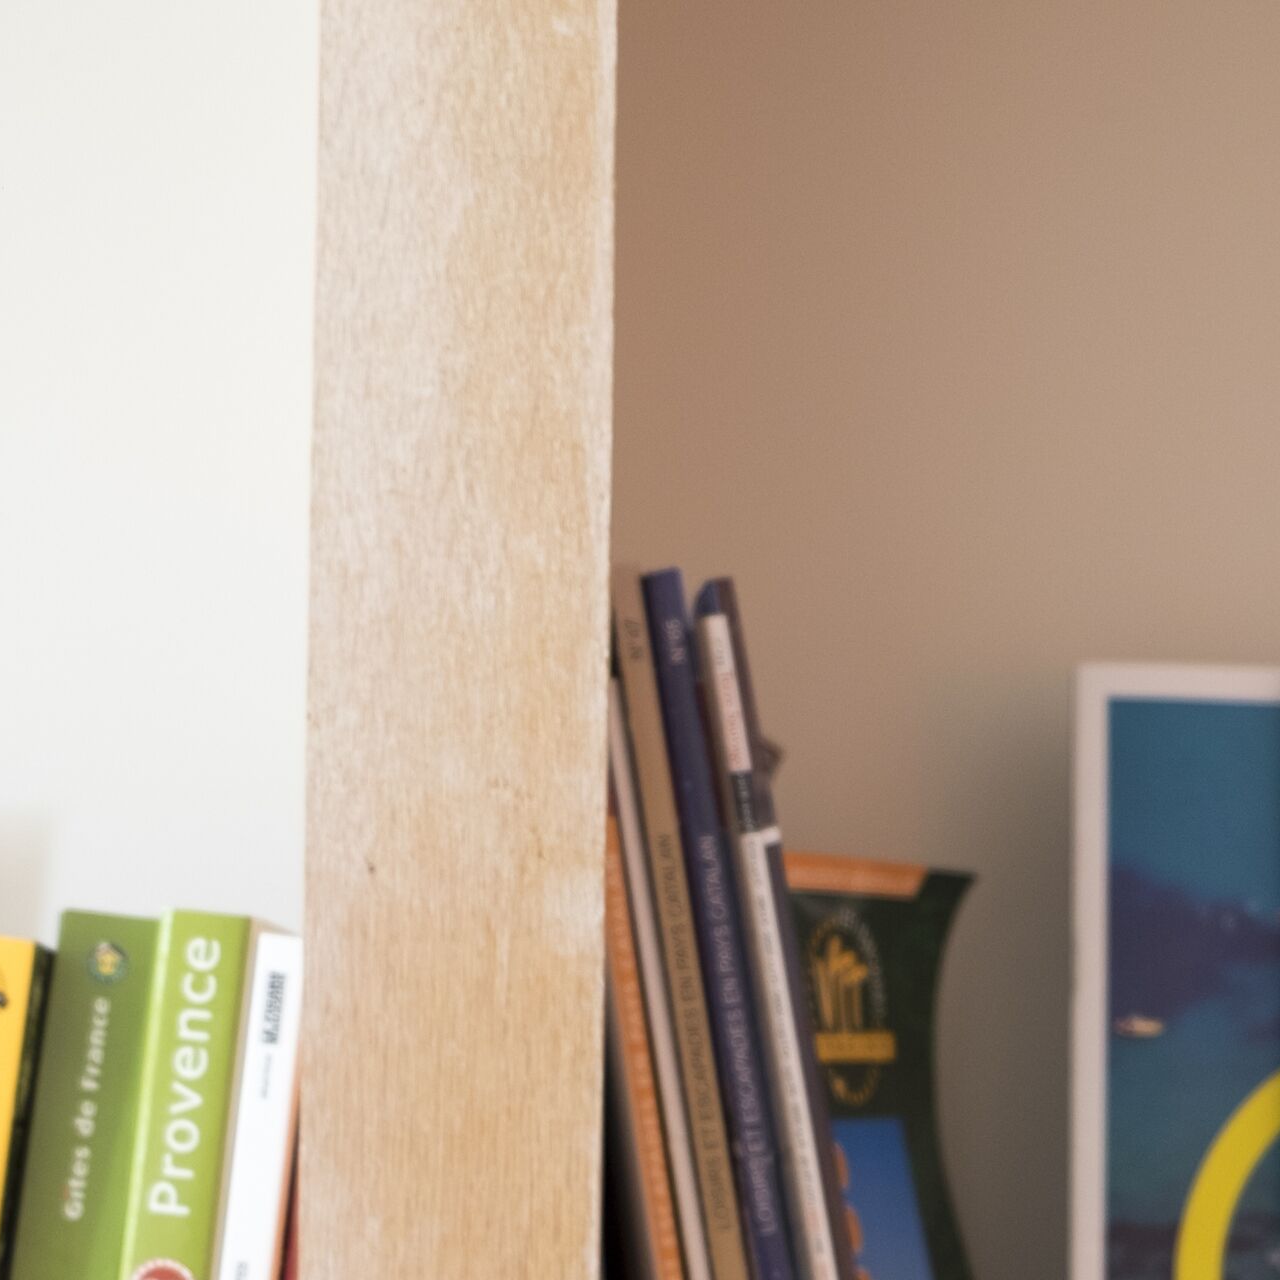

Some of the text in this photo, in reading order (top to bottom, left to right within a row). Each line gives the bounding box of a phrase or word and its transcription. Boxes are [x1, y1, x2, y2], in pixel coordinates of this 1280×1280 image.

[81, 998, 111, 1092] France
[148, 937, 220, 1217] Provence
[74, 1101, 97, 1138] de
